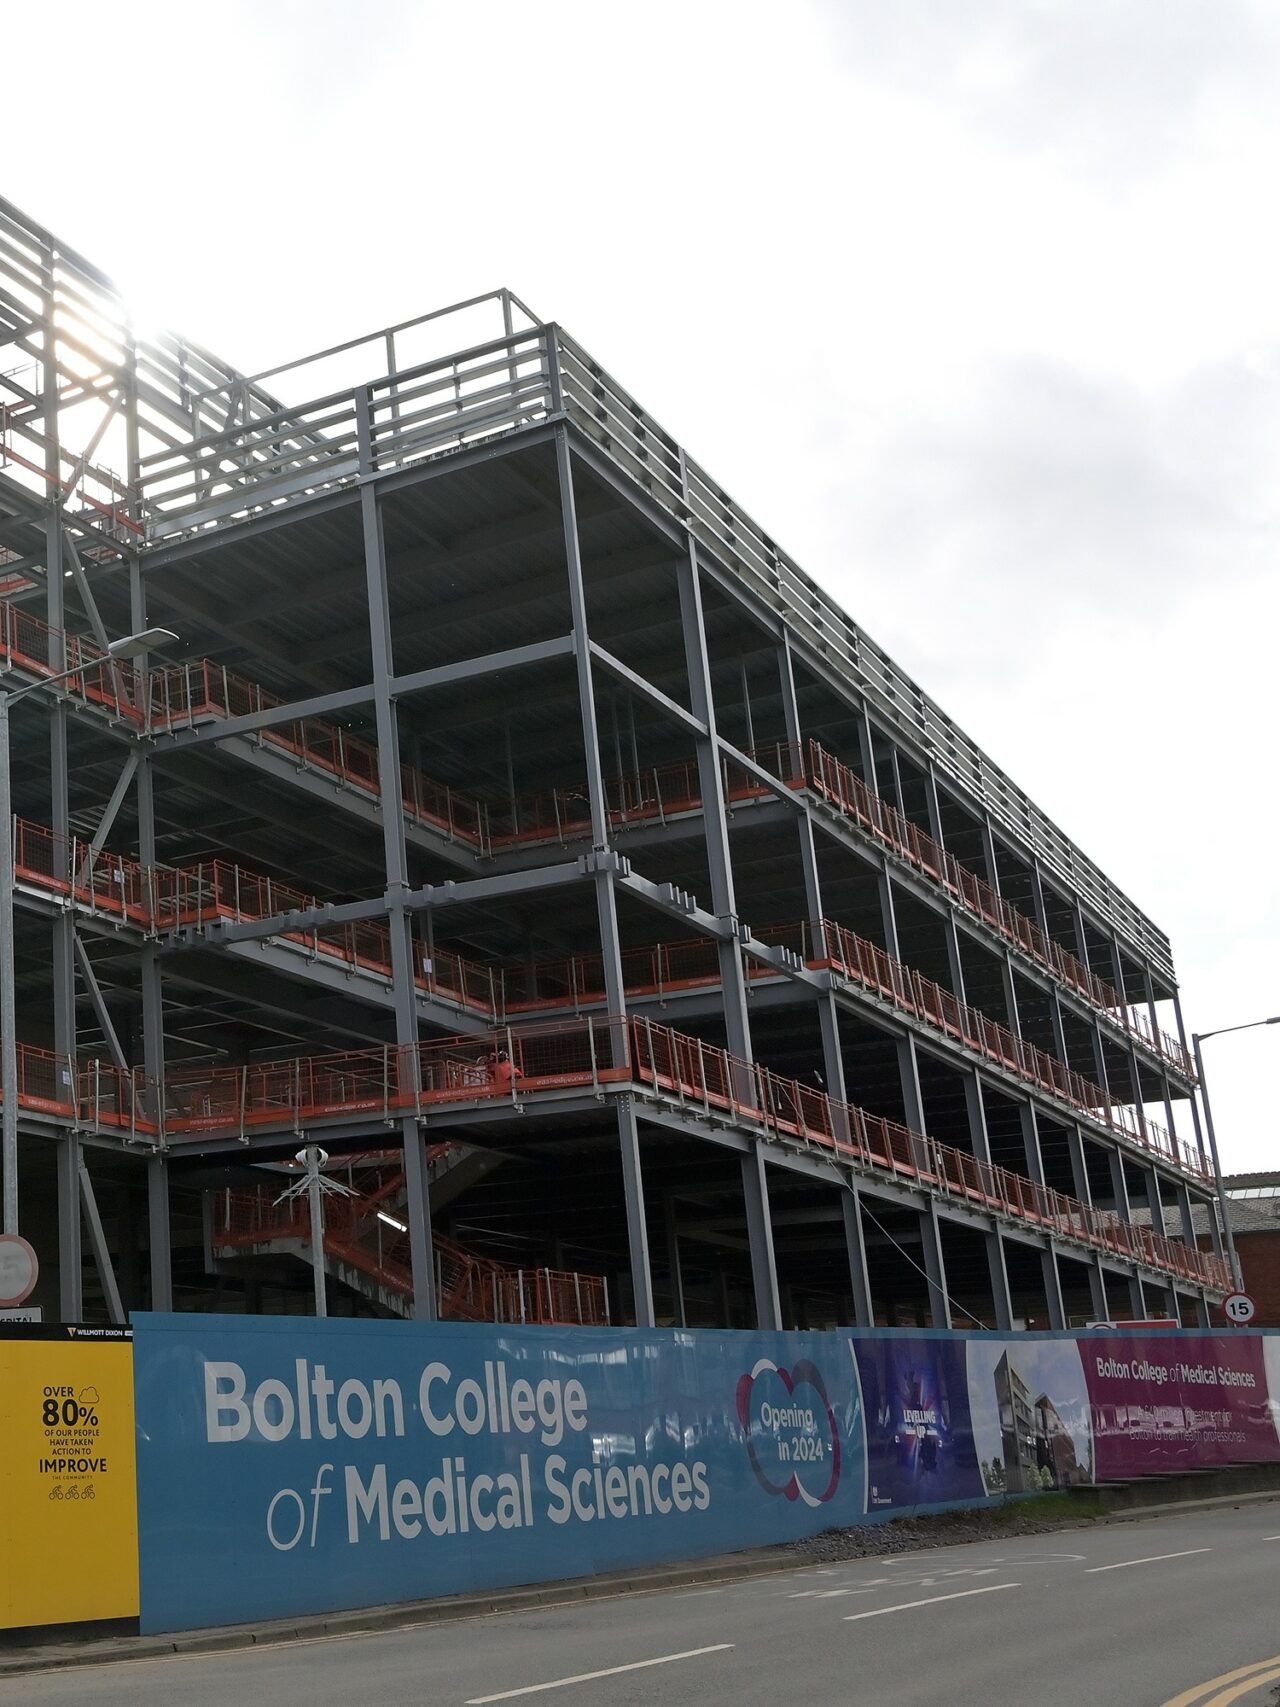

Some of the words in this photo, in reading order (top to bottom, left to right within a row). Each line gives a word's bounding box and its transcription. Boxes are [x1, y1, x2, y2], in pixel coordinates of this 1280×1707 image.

[1229, 1302, 1249, 1315] 15
[1096, 1356, 1130, 1379] Bolton
[1131, 1359, 1168, 1385] College
[1169, 1363, 1180, 1383] of
[1180, 1364, 1218, 1385] Medical
[1218, 1366, 1256, 1388] Sciences
[43, 1386, 74, 1397] OVER
[204, 1358, 405, 1444] Bolton
[419, 1360, 588, 1446] College
[42, 1398, 99, 1427] 80%
[761, 1401, 814, 1433] Opening
[903, 1409, 936, 1424] LEVELLING
[44, 1429, 55, 1437] OF
[56, 1429, 72, 1437] OUR
[73, 1429, 100, 1437] PEOPLE
[916, 1425, 927, 1439] UP
[49, 1438, 69, 1446] HAVE
[70, 1438, 94, 1446] TAKEN
[777, 1435, 791, 1461] in
[791, 1436, 824, 1461] 2024
[51, 1448, 80, 1456] ACTION
[39, 1458, 107, 1473] IMPROVE
[266, 1462, 334, 1551] of
[344, 1454, 535, 1544] Medical
[544, 1452, 711, 1526] Sciences
